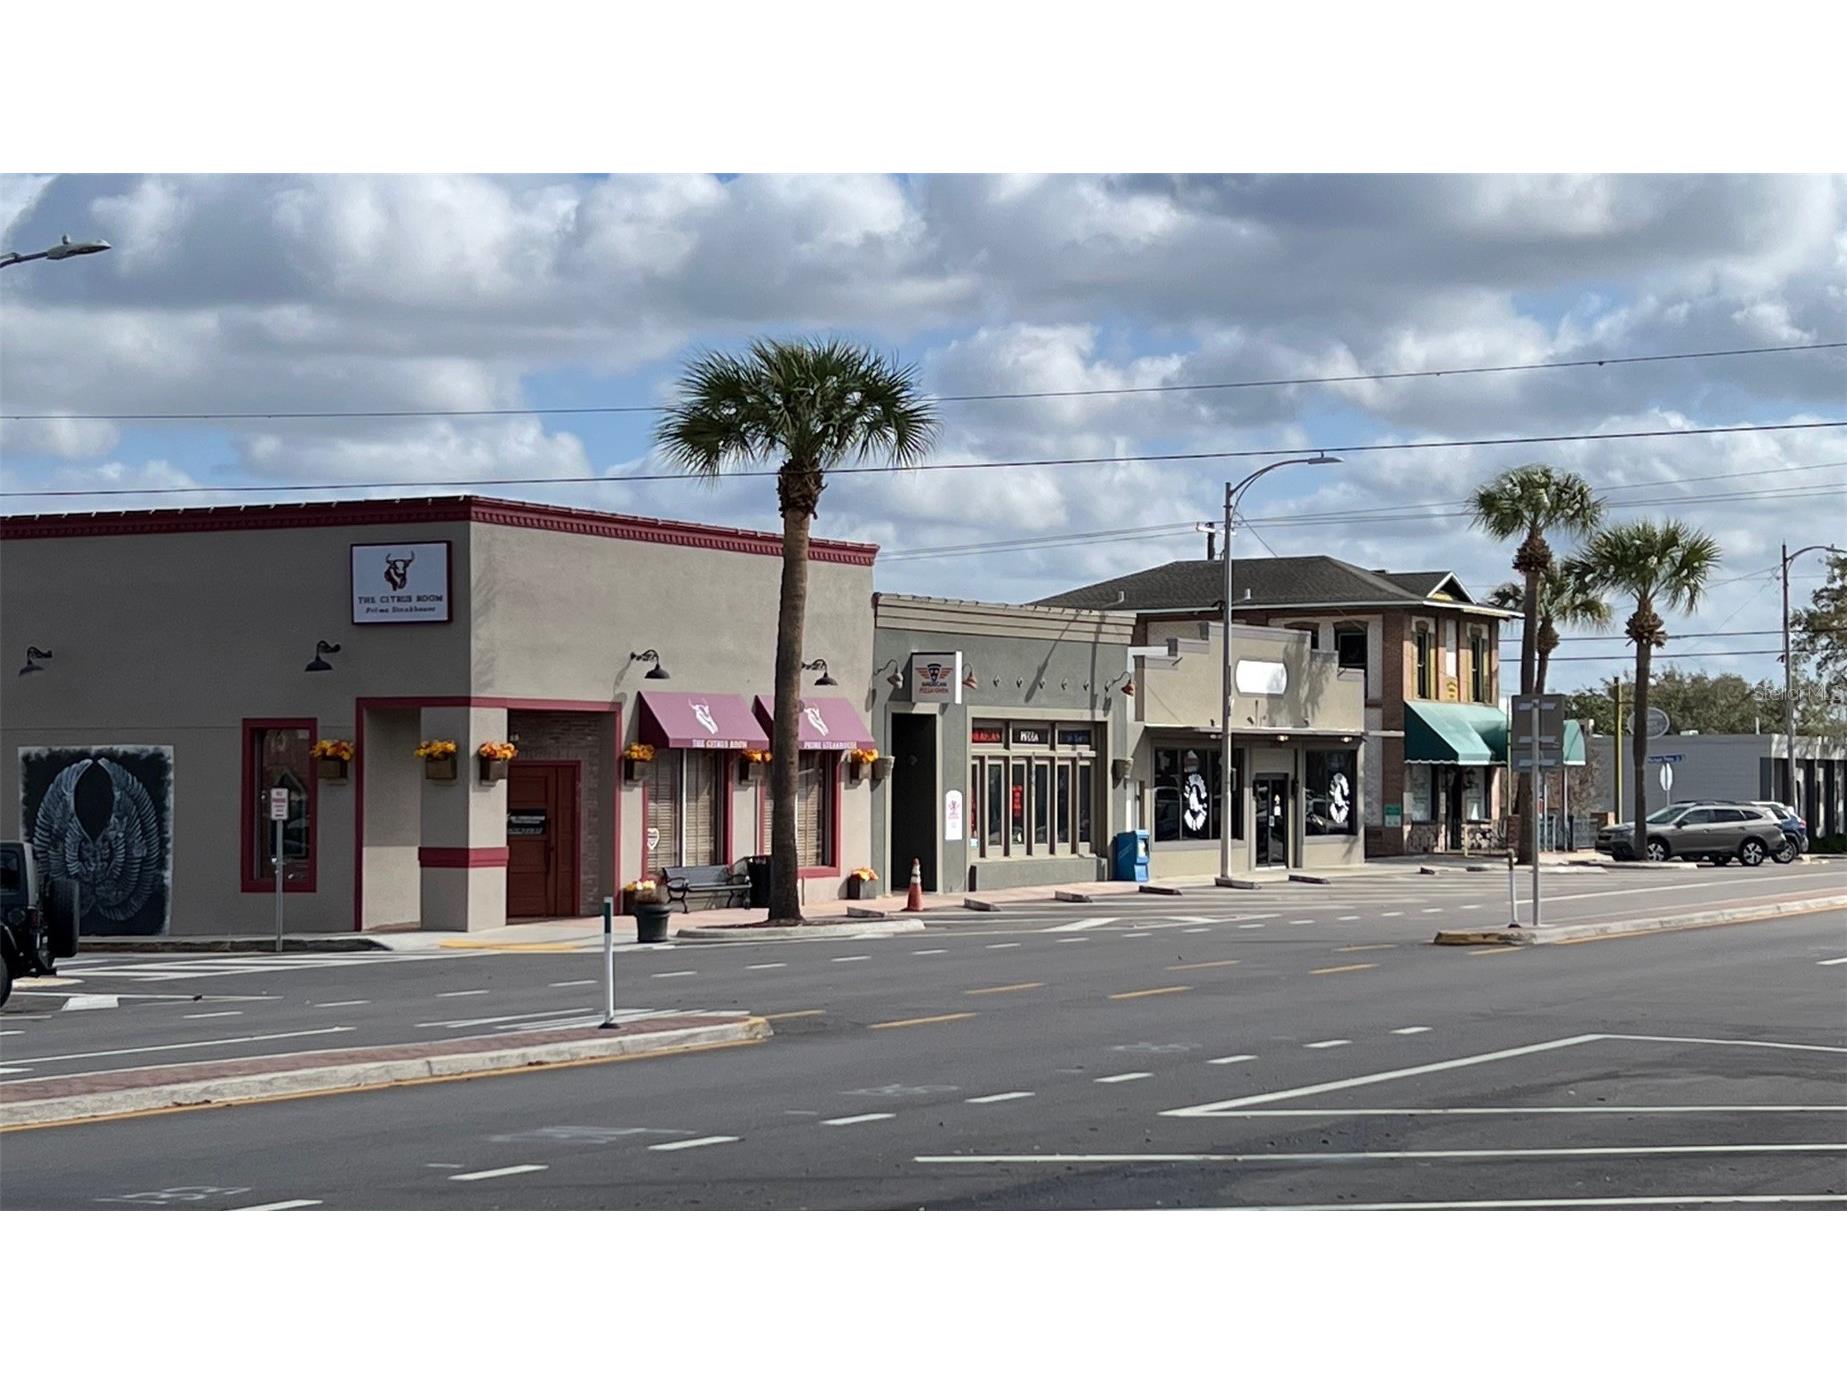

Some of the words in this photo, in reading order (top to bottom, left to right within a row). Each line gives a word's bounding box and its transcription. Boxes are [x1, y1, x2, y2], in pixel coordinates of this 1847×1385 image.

[358, 596, 377, 604] THE
[380, 595, 412, 603] CITRUS
[416, 594, 443, 602] ROOM
[692, 739, 705, 748] THE
[705, 740, 728, 748] CITRUS
